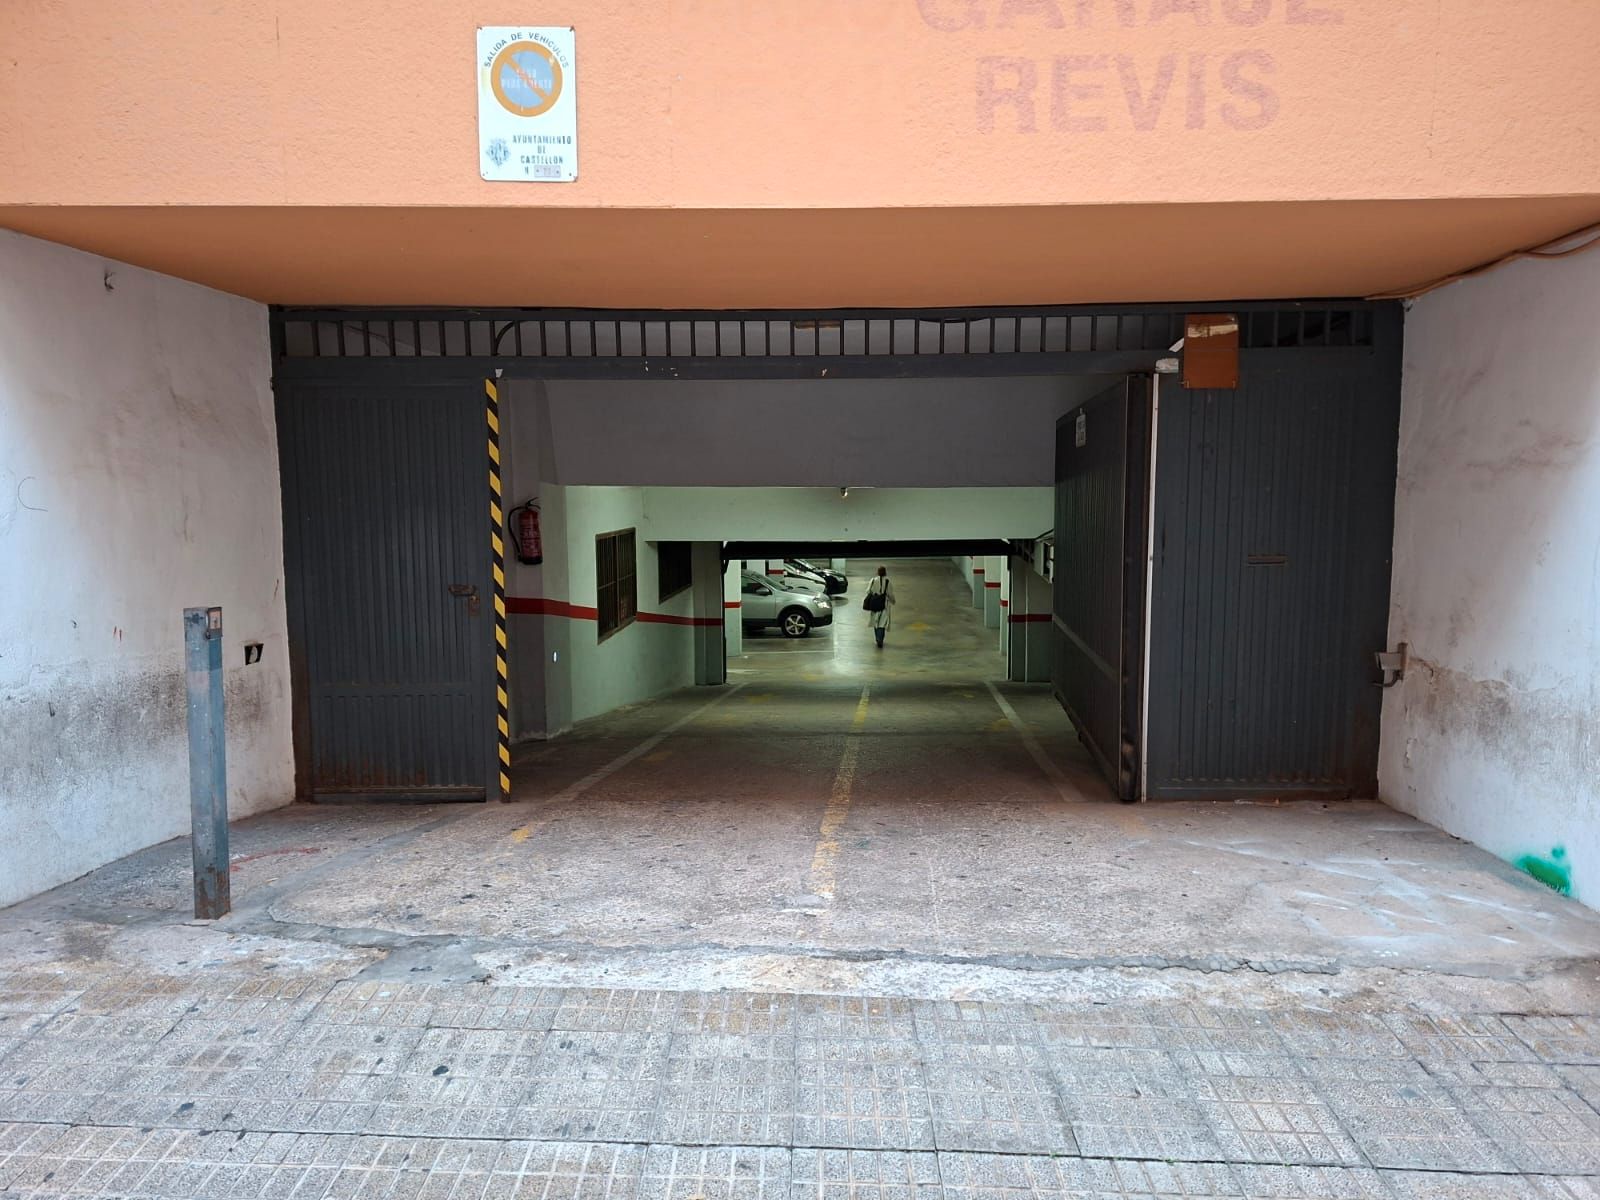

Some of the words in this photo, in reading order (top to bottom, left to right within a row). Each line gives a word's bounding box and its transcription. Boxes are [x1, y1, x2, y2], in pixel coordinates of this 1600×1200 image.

[484, 39, 508, 68] SALIDA
[511, 32, 523, 41] DE
[528, 31, 569, 69] VEHICULOS
[975, 50, 1281, 134] REVIS
[512, 135, 572, 144] AYUNTAMIENTO
